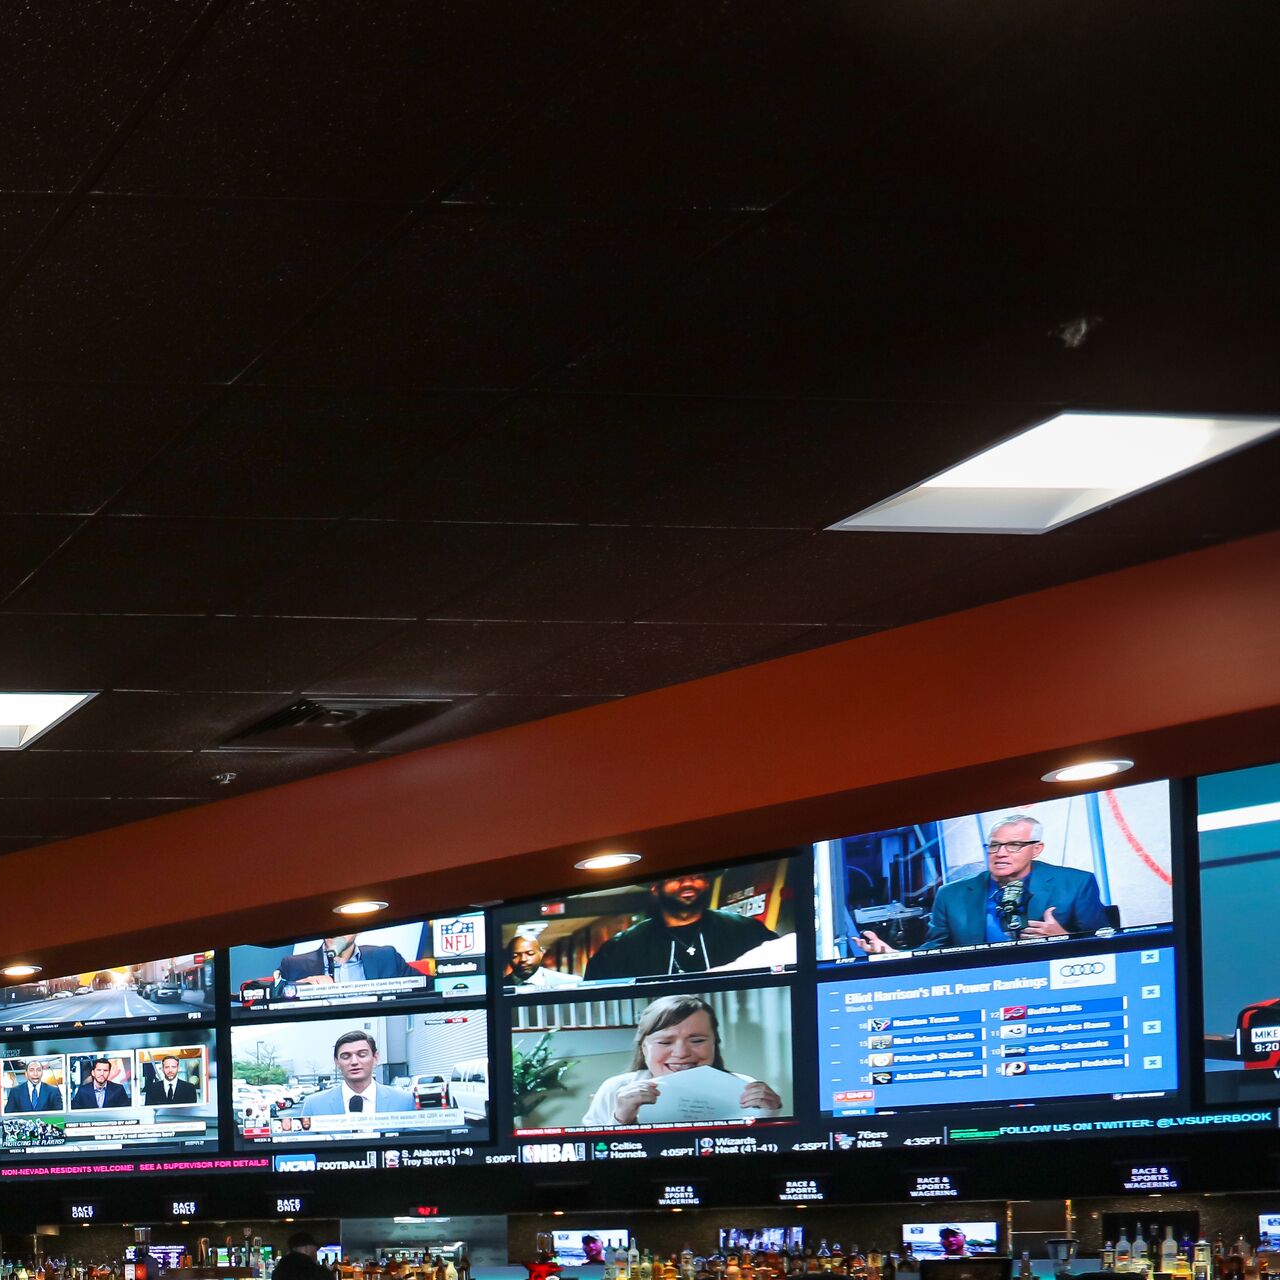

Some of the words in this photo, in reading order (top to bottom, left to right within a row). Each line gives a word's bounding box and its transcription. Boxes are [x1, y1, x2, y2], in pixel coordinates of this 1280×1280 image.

[444, 935, 472, 951] NFL
[845, 992, 872, 1005] Elliot
[874, 987, 929, 1003] Harrison's
[931, 984, 953, 997] NFL
[955, 980, 992, 995] Power
[994, 976, 1048, 993] Rankings
[1027, 1006, 1059, 1017] Buffalo
[1061, 1004, 1082, 1013] Bills
[893, 1016, 927, 1028] Houston
[929, 1014, 959, 1024] Texans
[1028, 1026, 1044, 1035] Los
[1045, 1023, 1081, 1034] Angeles
[1083, 1019, 1110, 1029] Rams
[893, 1036, 911, 1045] New
[913, 1033, 945, 1043] Orleans
[947, 1031, 974, 1041] Saints
[1254, 1030, 1279, 1040] MIKE
[1028, 1042, 1061, 1054] Seattle
[1062, 1039, 1109, 1050] Seahawks
[1254, 1043, 1280, 1052] 9:20
[894, 1051, 937, 1064] Pittsburgh
[939, 1049, 974, 1060] Steelers
[1029, 1060, 1079, 1073] Washington
[1081, 1057, 1123, 1069] Redskins
[894, 1070, 944, 1082] Jacksonville
[1000, 1125, 1051, 1135] FOLLOW
[1053, 1123, 1071, 1132] US
[1073, 1122, 1092, 1131] ON
[1094, 1118, 1154, 1129] TWITTER:
[1157, 1111, 1271, 1128] @LVSUPERBOOK
[857, 1130, 888, 1140] 76ers
[611, 1141, 642, 1150] Celtics
[715, 1136, 756, 1146] Wizards
[792, 1141, 828, 1151] 4:35PT
[857, 1139, 883, 1148] Nets
[903, 1136, 942, 1146] 4:35PT
[402, 1150, 412, 1158] S.
[413, 1149, 449, 1157] Alabama
[452, 1148, 473, 1157] (1-4)
[533, 1143, 576, 1162] NBA
[611, 1150, 647, 1159] Hornets
[660, 1148, 694, 1158] 4:05PT
[715, 1145, 738, 1155] Heat
[740, 1144, 778, 1155] (41-41)
[402, 1158, 422, 1167] Troy
[423, 1157, 432, 1166] St
[434, 1156, 456, 1166] (4-1)
[485, 1154, 517, 1164] 5:00PT
[2, 1168, 50, 1176] NON-NEVADA
[50, 1166, 91, 1175] RESIDENTS
[92, 1164, 135, 1173] WELCOME!
[139, 1163, 155, 1171] SEE
[163, 1161, 213, 1170] SUPERVISOR
[214, 1160, 232, 1168] FOR
[233, 1159, 269, 1168] DETAILS!
[279, 1160, 316, 1172] NCAA
[317, 1160, 369, 1171] FOOTBALL
[1124, 1181, 1177, 1189] WAGERING
